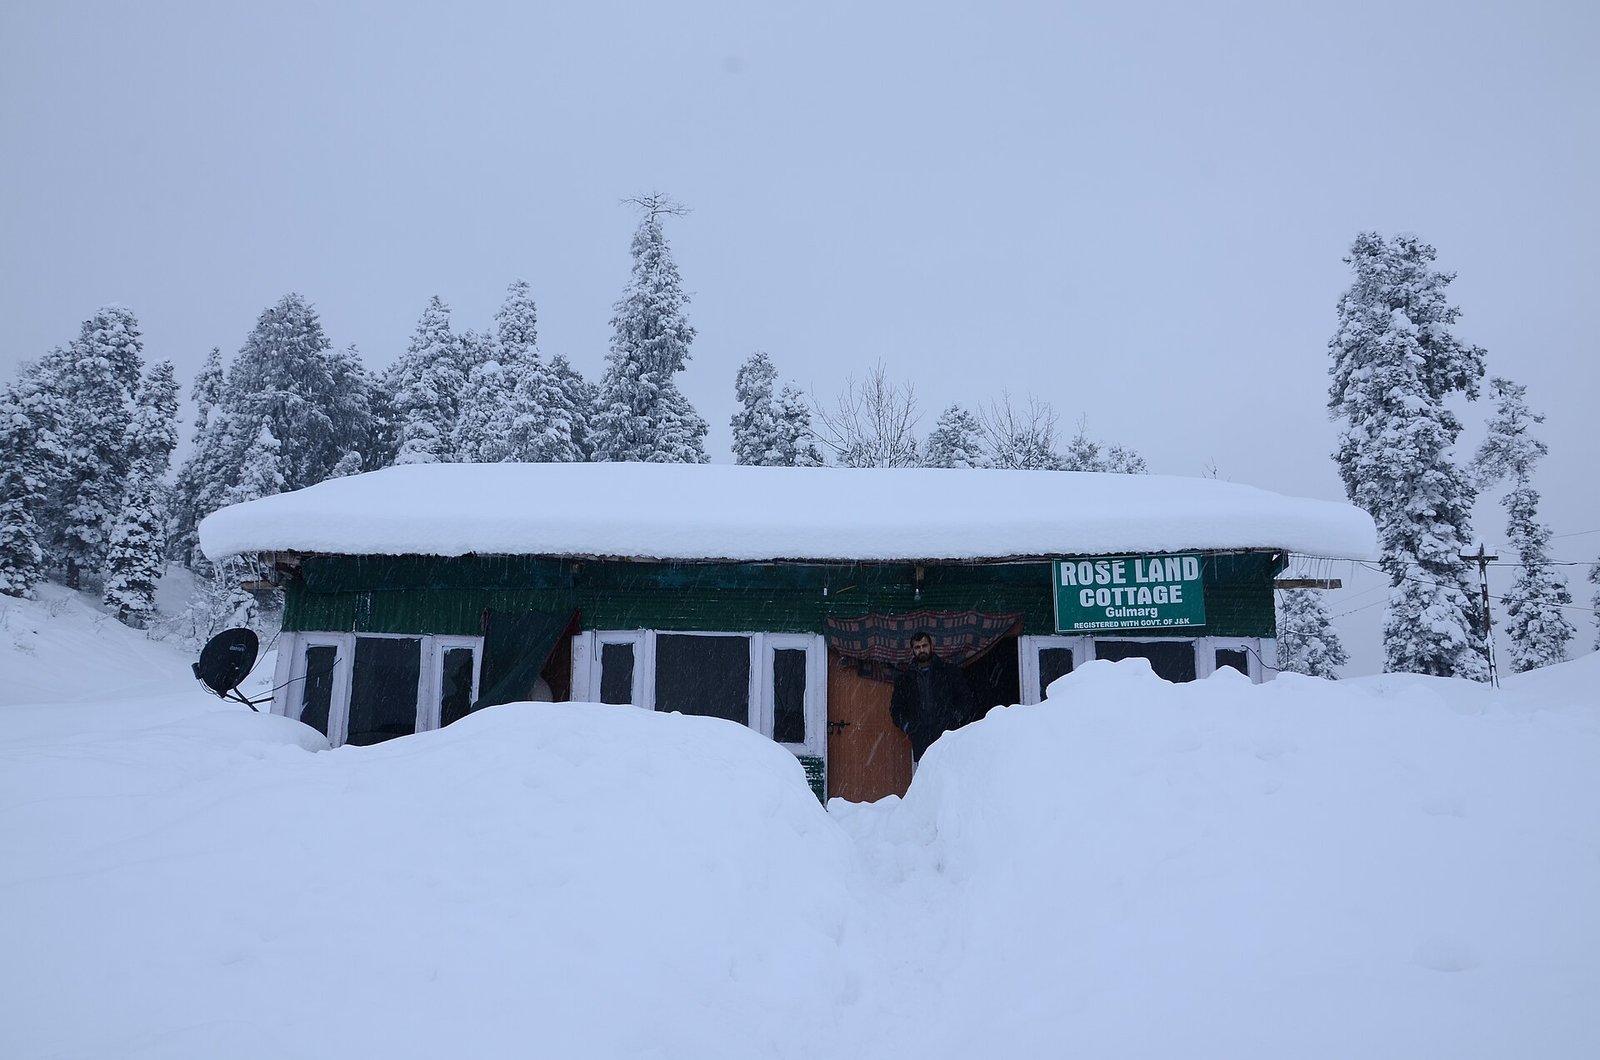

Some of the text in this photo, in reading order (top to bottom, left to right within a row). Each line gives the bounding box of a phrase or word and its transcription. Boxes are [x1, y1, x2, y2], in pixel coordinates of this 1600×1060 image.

[1060, 556, 1199, 586] ROSE LAND
[1079, 585, 1183, 607] COTTAGE
[1105, 607, 1158, 618] Gulmarg
[1074, 621, 1119, 629] REGISTERED
